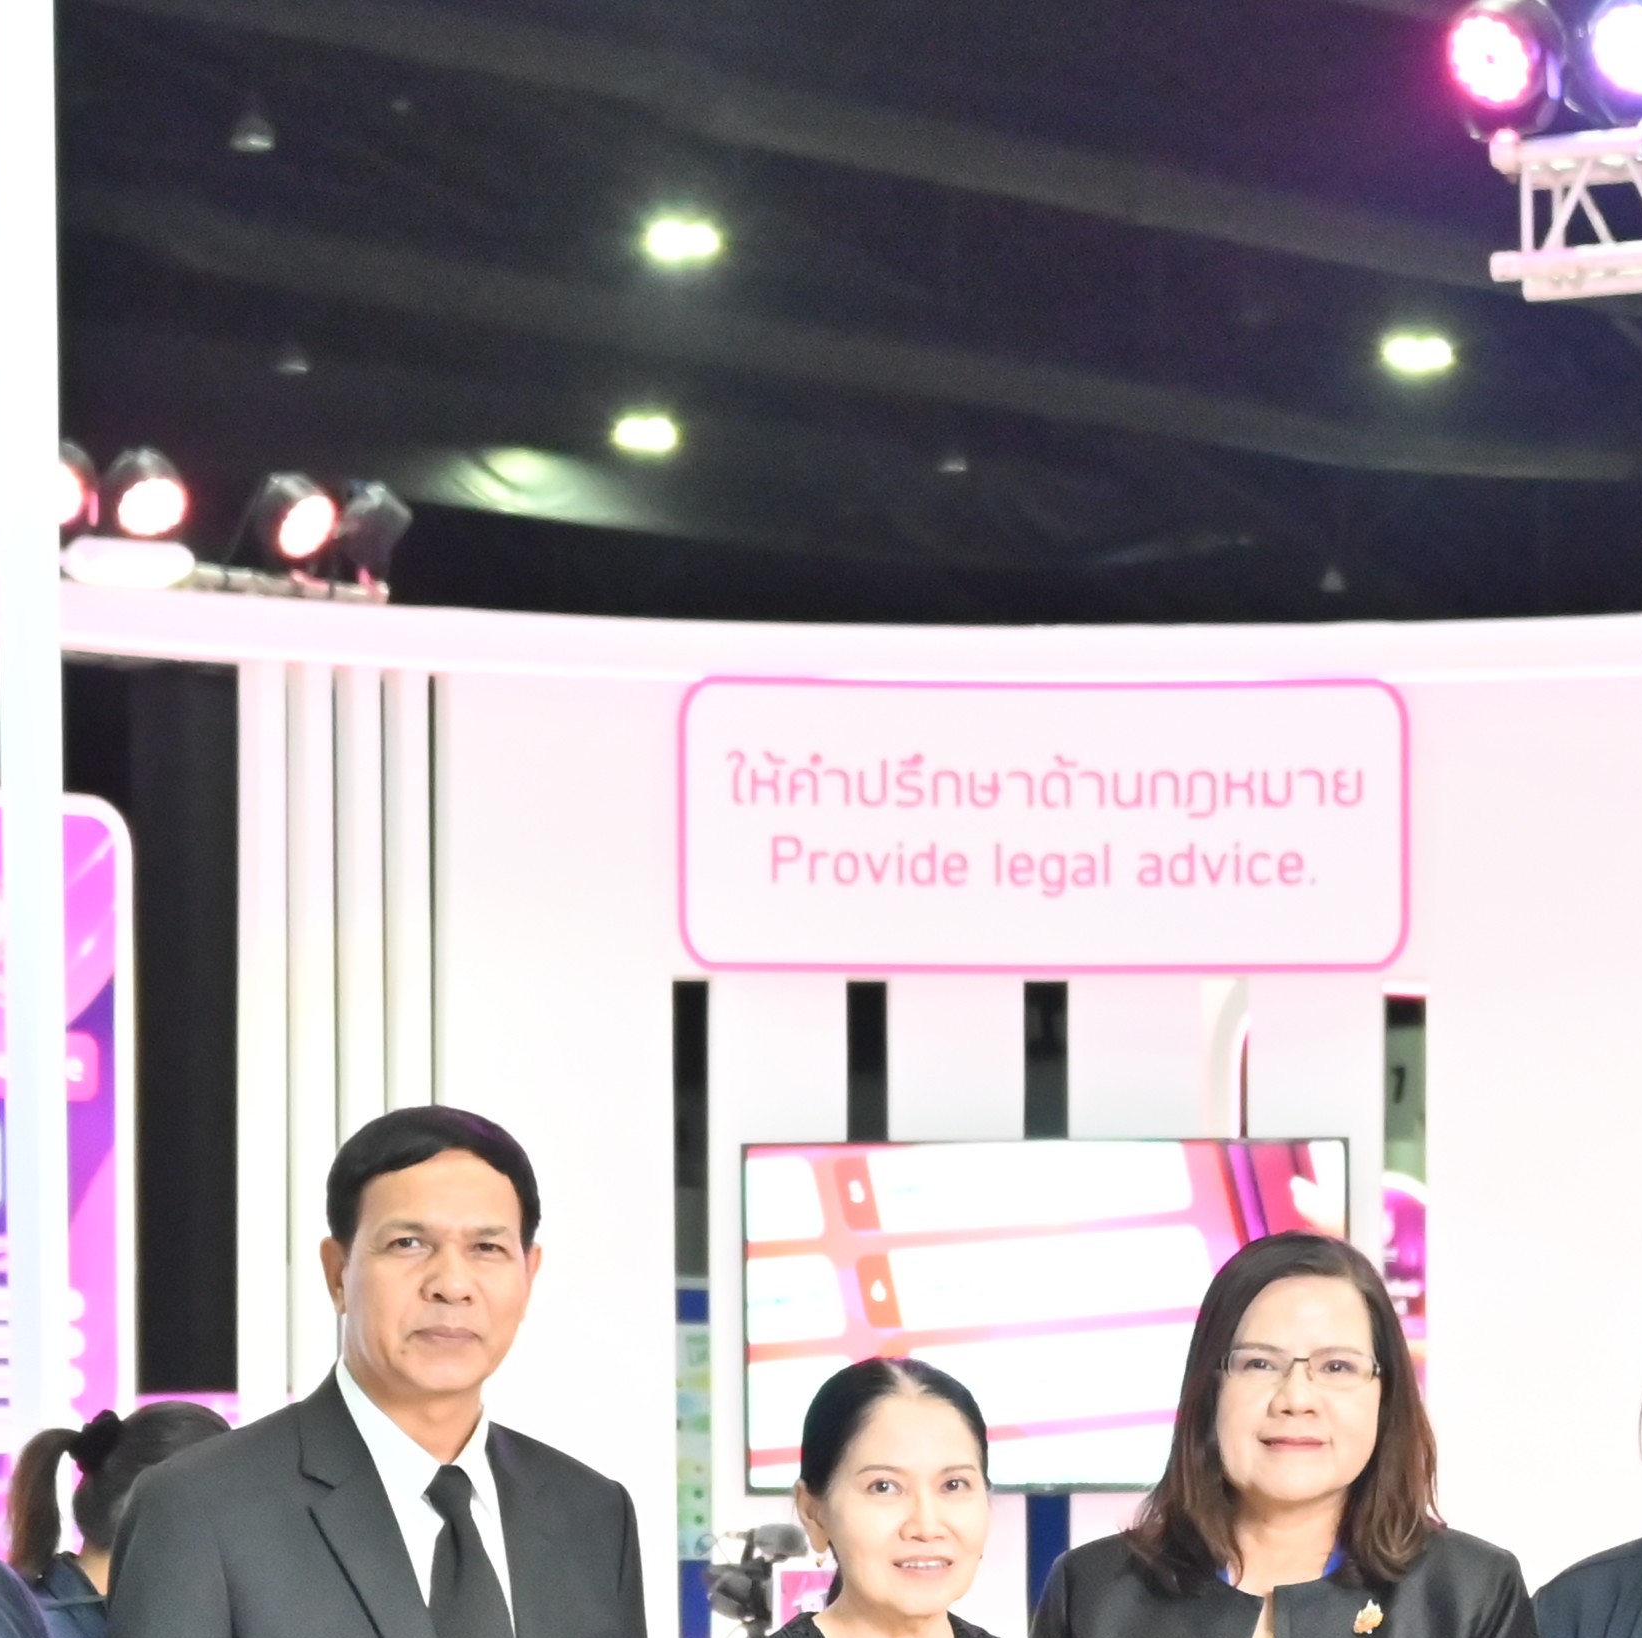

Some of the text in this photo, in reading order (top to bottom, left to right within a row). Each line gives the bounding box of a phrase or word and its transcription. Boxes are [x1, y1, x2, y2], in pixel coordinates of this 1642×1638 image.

[726, 749, 1364, 819] ให้คำปรึกษาด้านกฎหมาย
[769, 835, 1318, 898] Provide legal advice.
